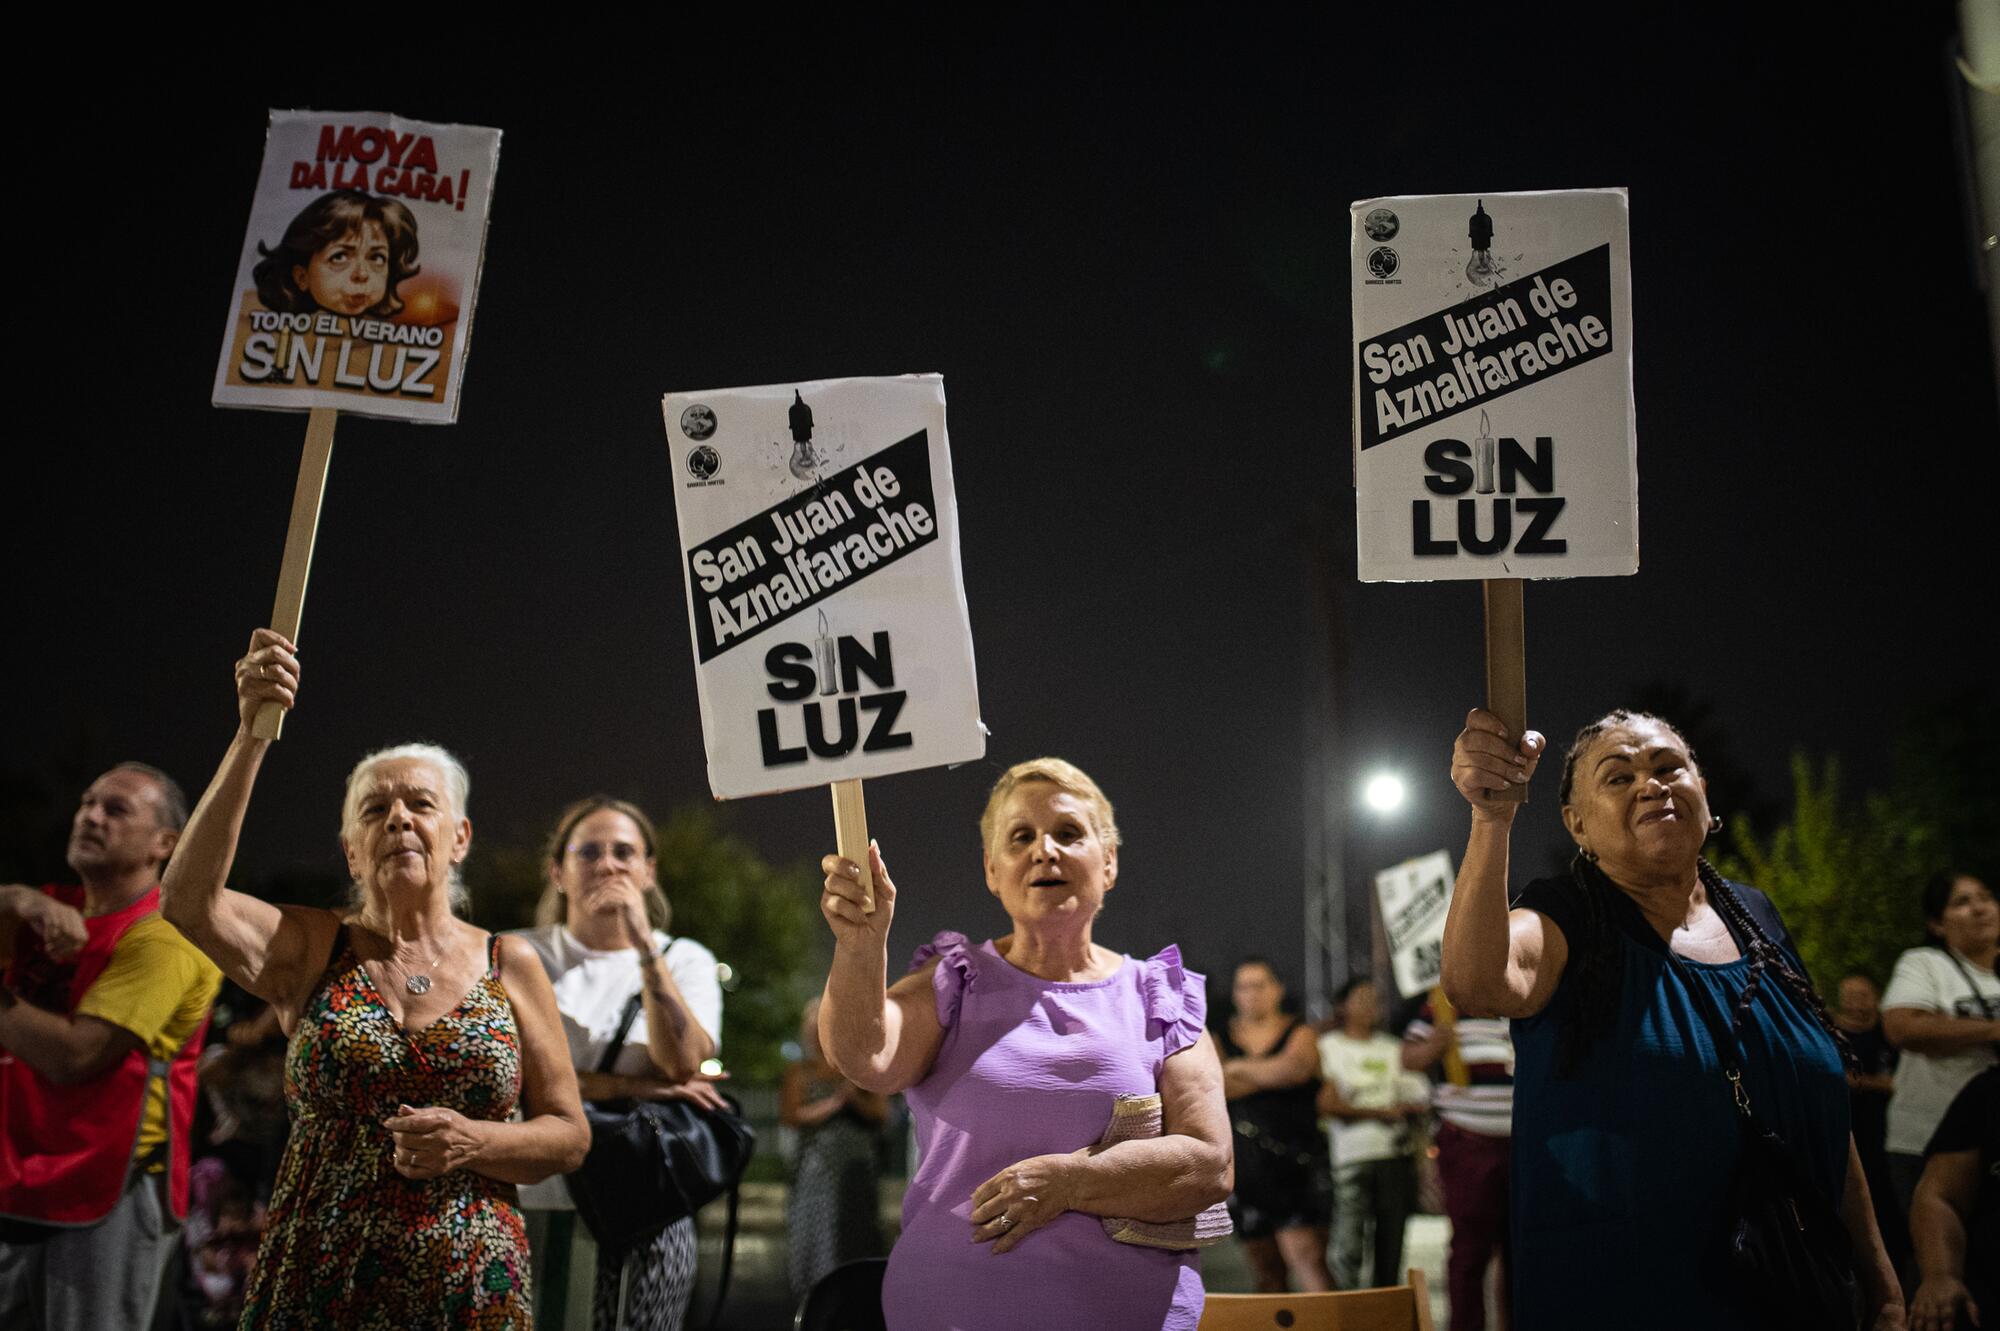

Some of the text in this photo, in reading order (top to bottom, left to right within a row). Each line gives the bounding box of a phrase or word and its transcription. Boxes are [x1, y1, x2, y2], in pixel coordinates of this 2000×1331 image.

[289, 161, 327, 189] DA
[332, 163, 369, 192] LA
[316, 125, 438, 174] MOYA
[240, 330, 441, 394] SIN LUZ
[251, 311, 444, 347] TODO EL VERANO
[1363, 275, 1578, 385] San Juan de
[1375, 315, 1609, 436] Aznalfarache
[1424, 436, 1553, 496] SIN
[692, 464, 901, 593] San Juan de
[1412, 497, 1567, 556] LUZ
[708, 501, 934, 647] Aznalfarache
[765, 630, 895, 701] SIN
[757, 690, 913, 768] LUZ
